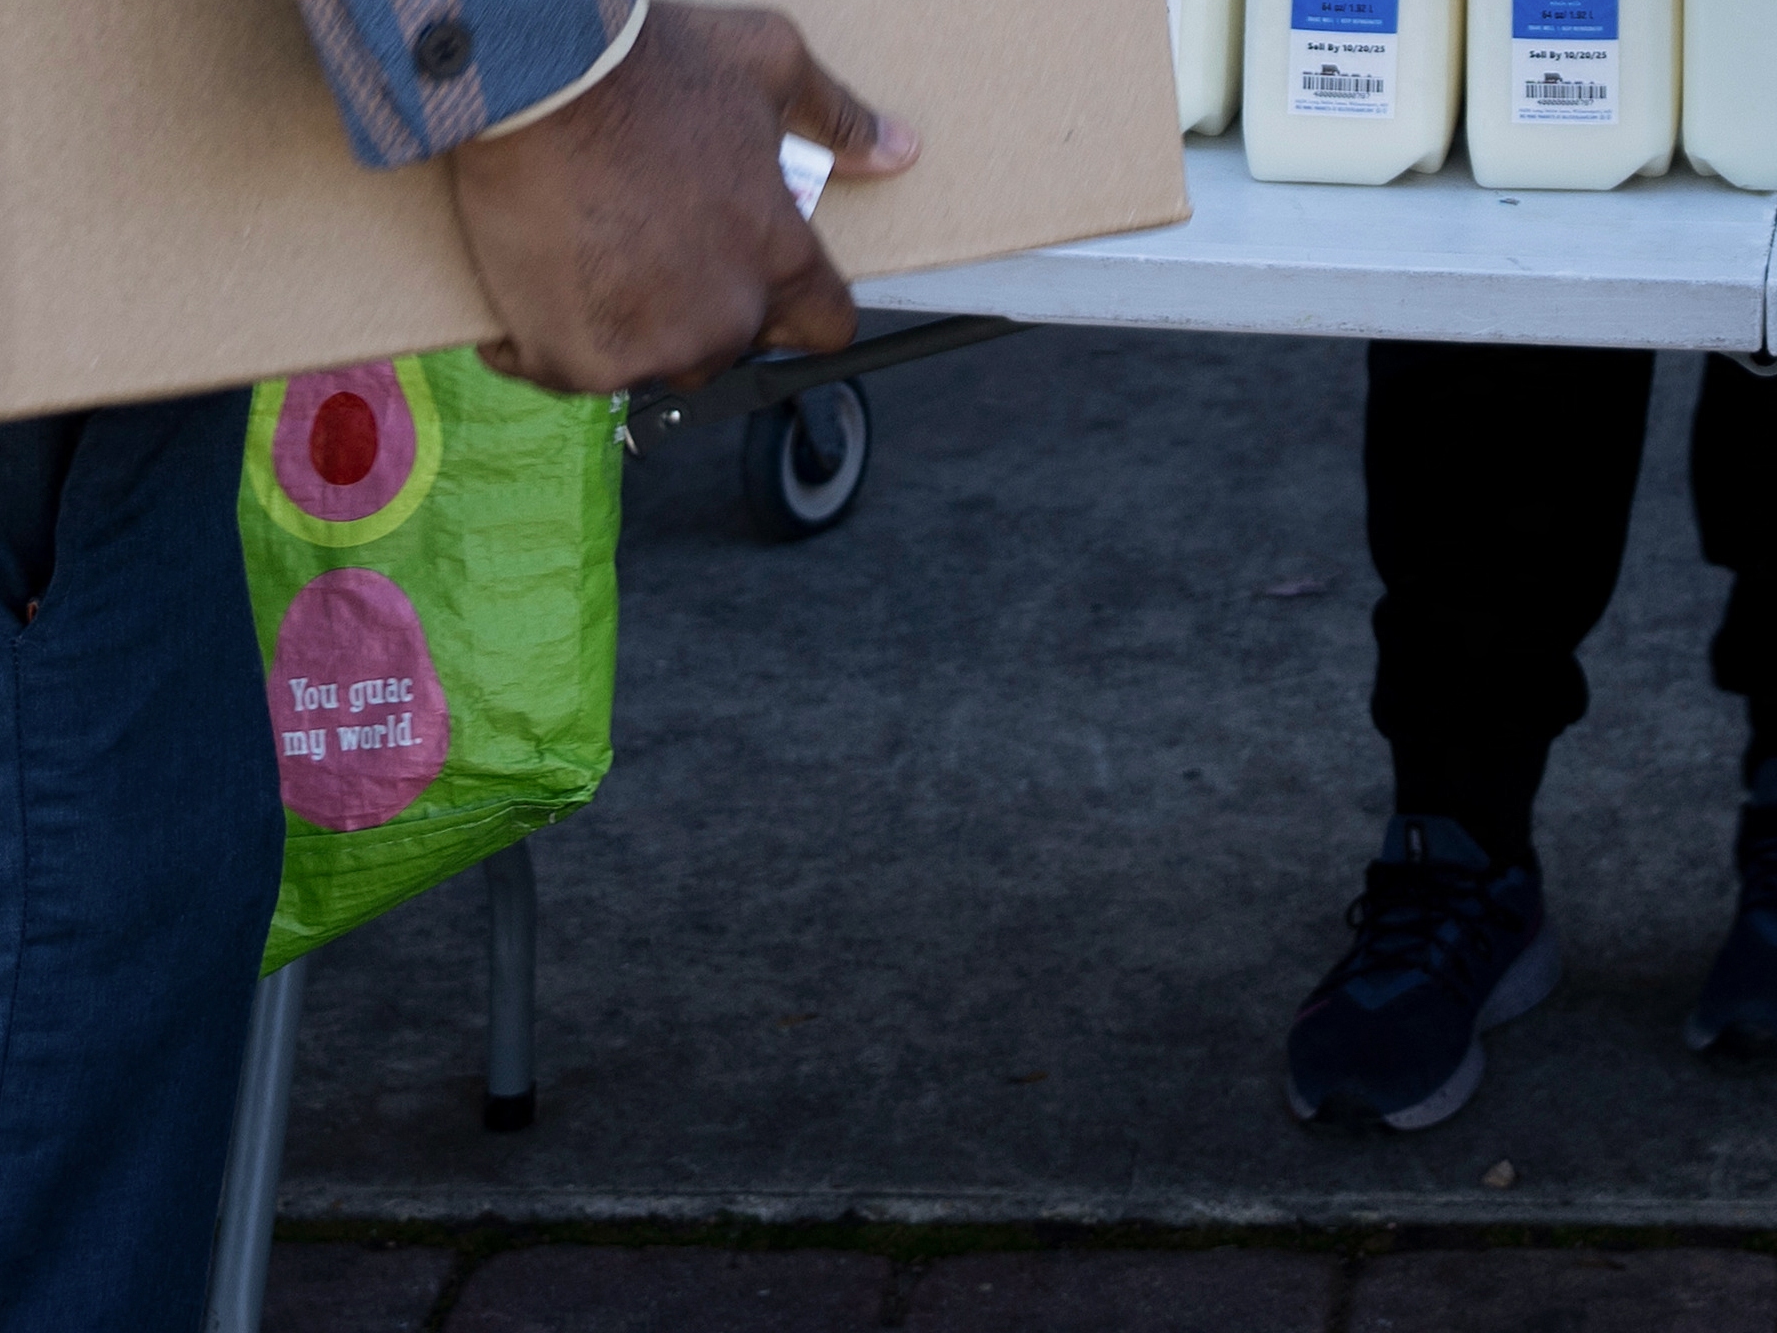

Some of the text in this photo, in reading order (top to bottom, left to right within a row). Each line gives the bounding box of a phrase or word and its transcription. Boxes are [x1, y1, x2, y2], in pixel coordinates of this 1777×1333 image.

[1307, 42, 1385, 54] Sell By 10/20/25
[1529, 50, 1607, 61] Sell By 10/20/25
[288, 677, 414, 713] You guac
[282, 712, 423, 761] my world.
